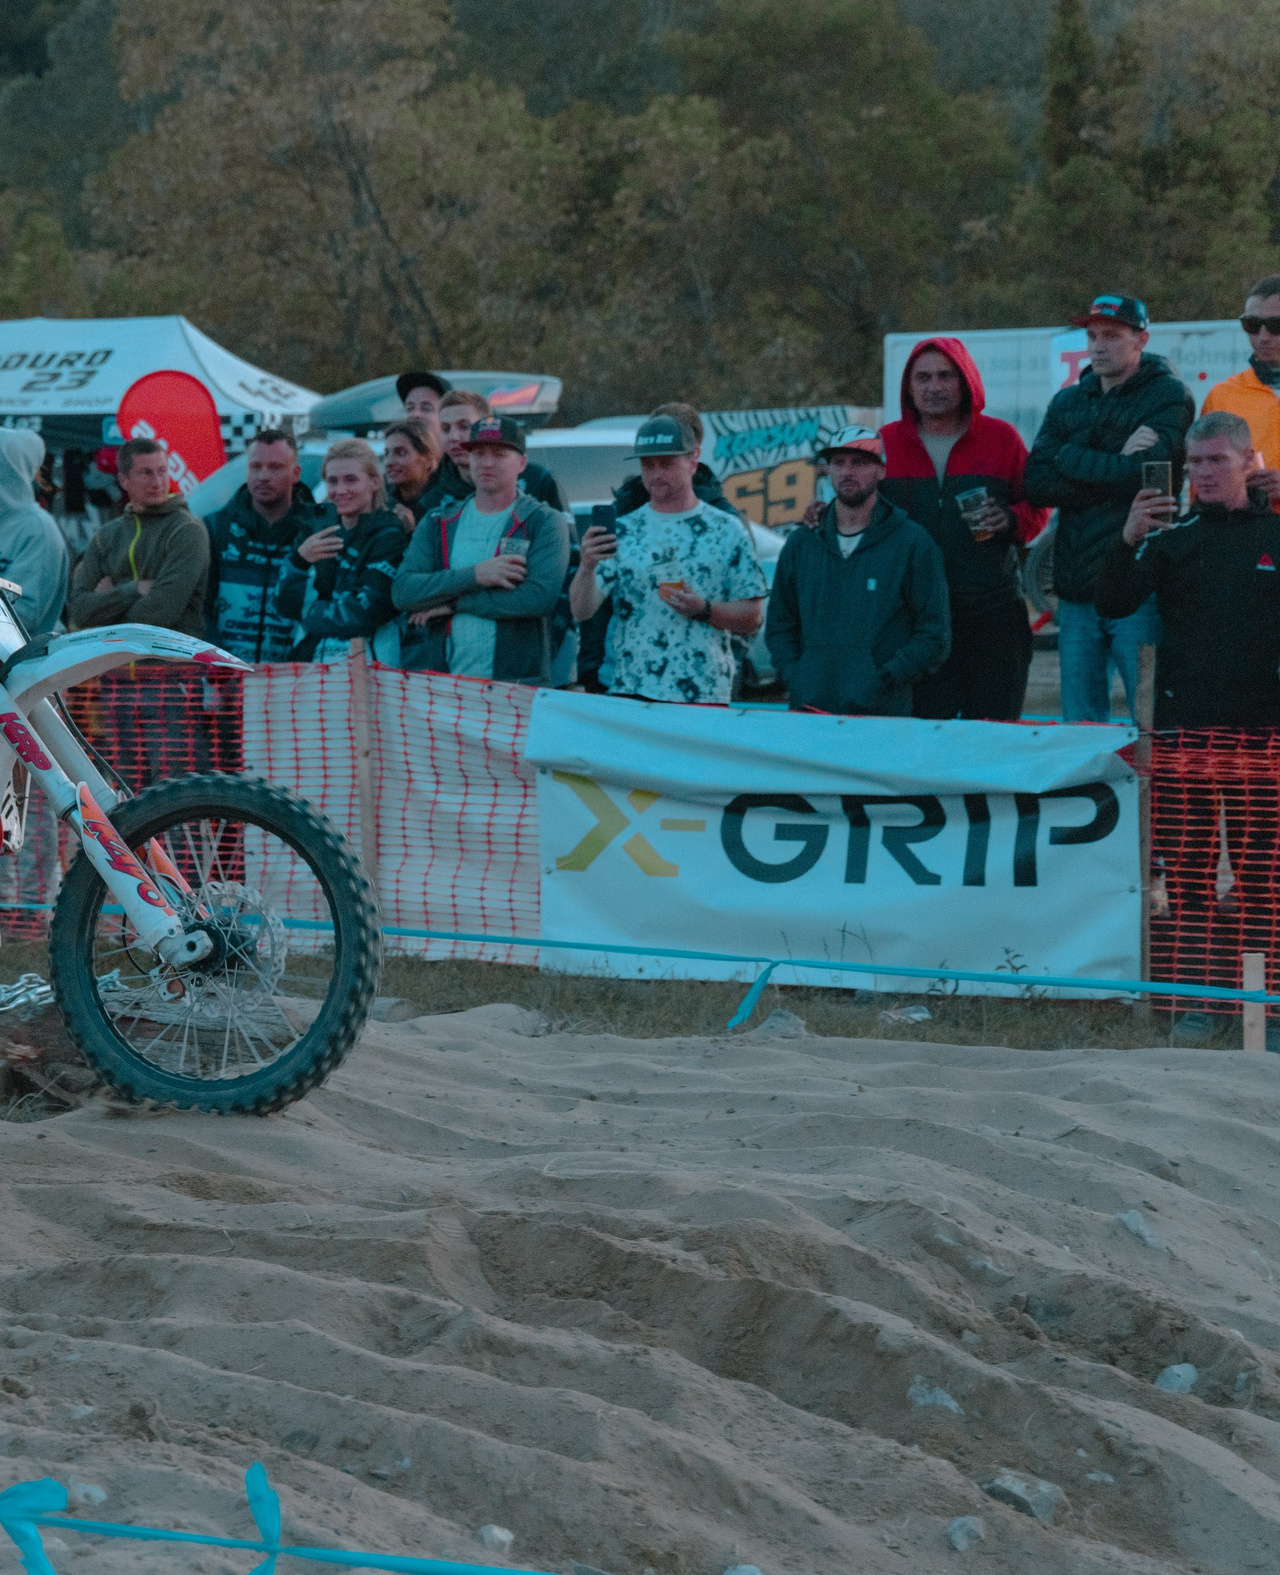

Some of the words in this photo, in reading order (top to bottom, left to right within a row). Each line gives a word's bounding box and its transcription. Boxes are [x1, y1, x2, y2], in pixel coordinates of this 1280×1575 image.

[20, 370, 99, 393] 23
[713, 418, 820, 460] KORSUN
[552, 769, 1121, 887] X-GRIP
[86, 820, 170, 908] KAYO
